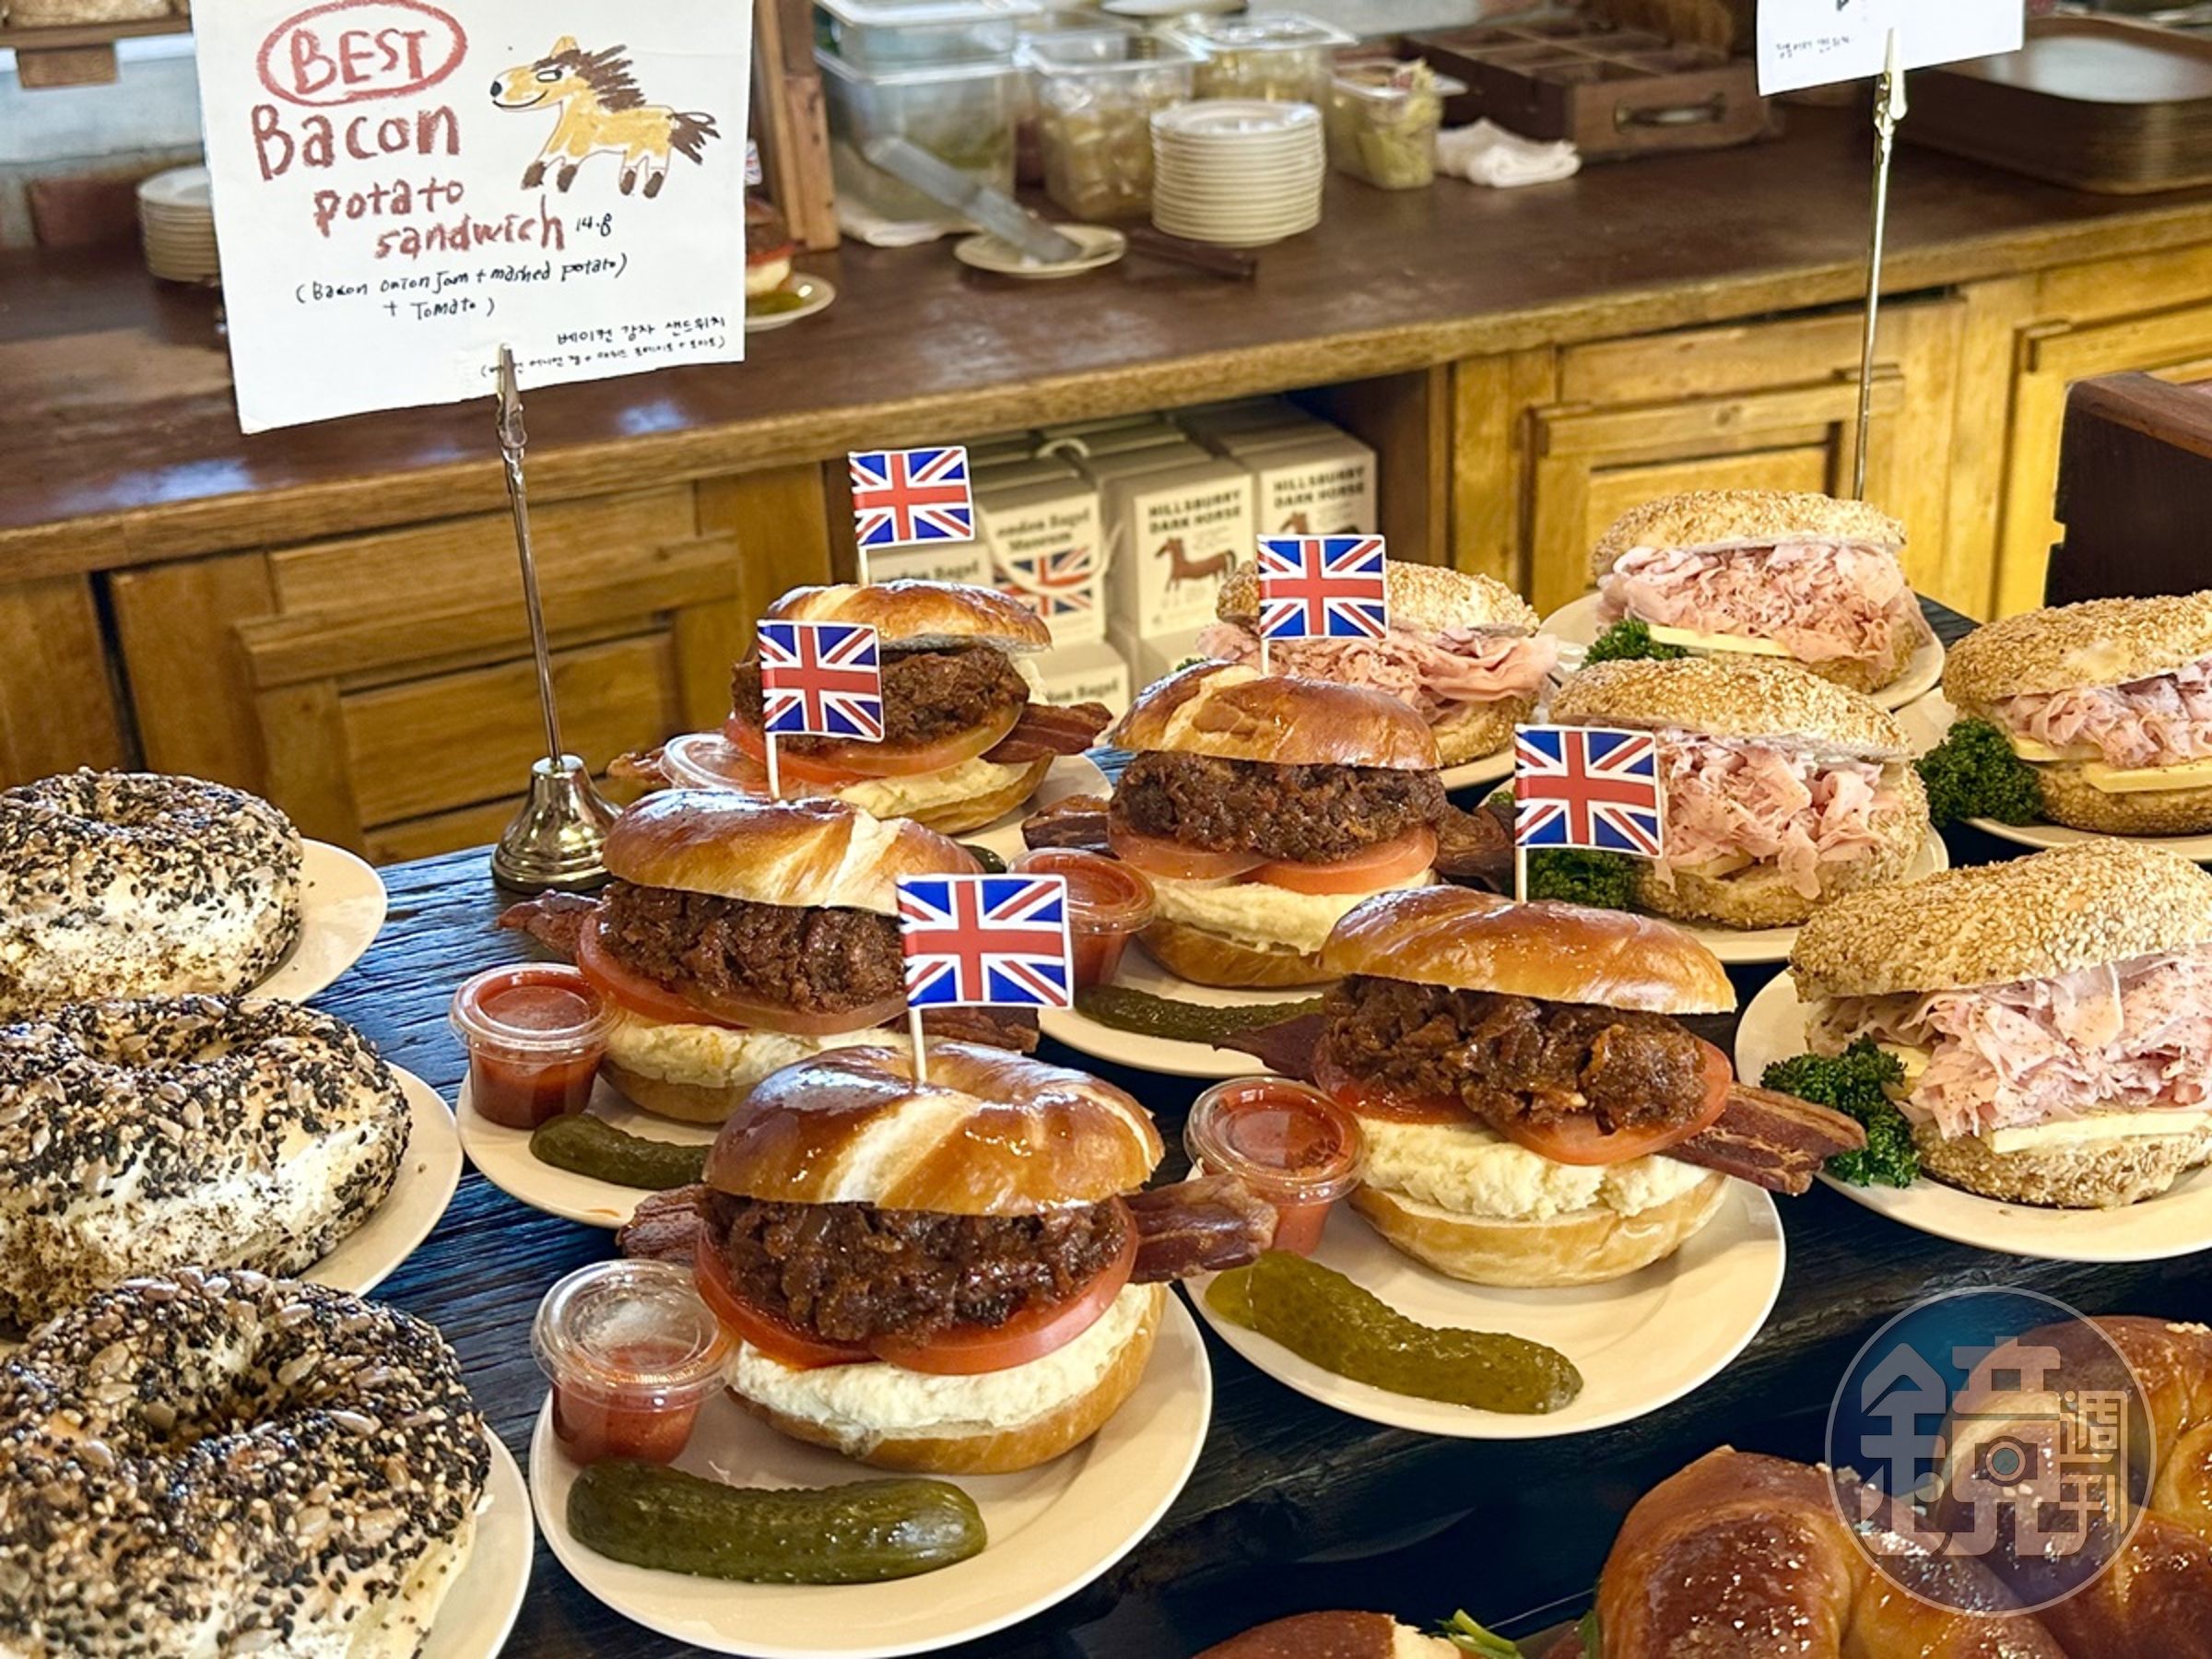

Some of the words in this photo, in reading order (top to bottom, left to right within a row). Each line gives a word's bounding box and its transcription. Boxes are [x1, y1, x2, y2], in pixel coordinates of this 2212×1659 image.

[289, 28, 429, 95] BEST
[251, 103, 461, 182] Bacon
[312, 176, 465, 239] potato
[373, 194, 566, 261] sandwich
[575, 213, 613, 237] 14.8
[1149, 517, 1189, 535] DARK
[1194, 506, 1241, 524] HORSE
[1274, 492, 1313, 510] DARK
[1318, 481, 1365, 500] HORSE
